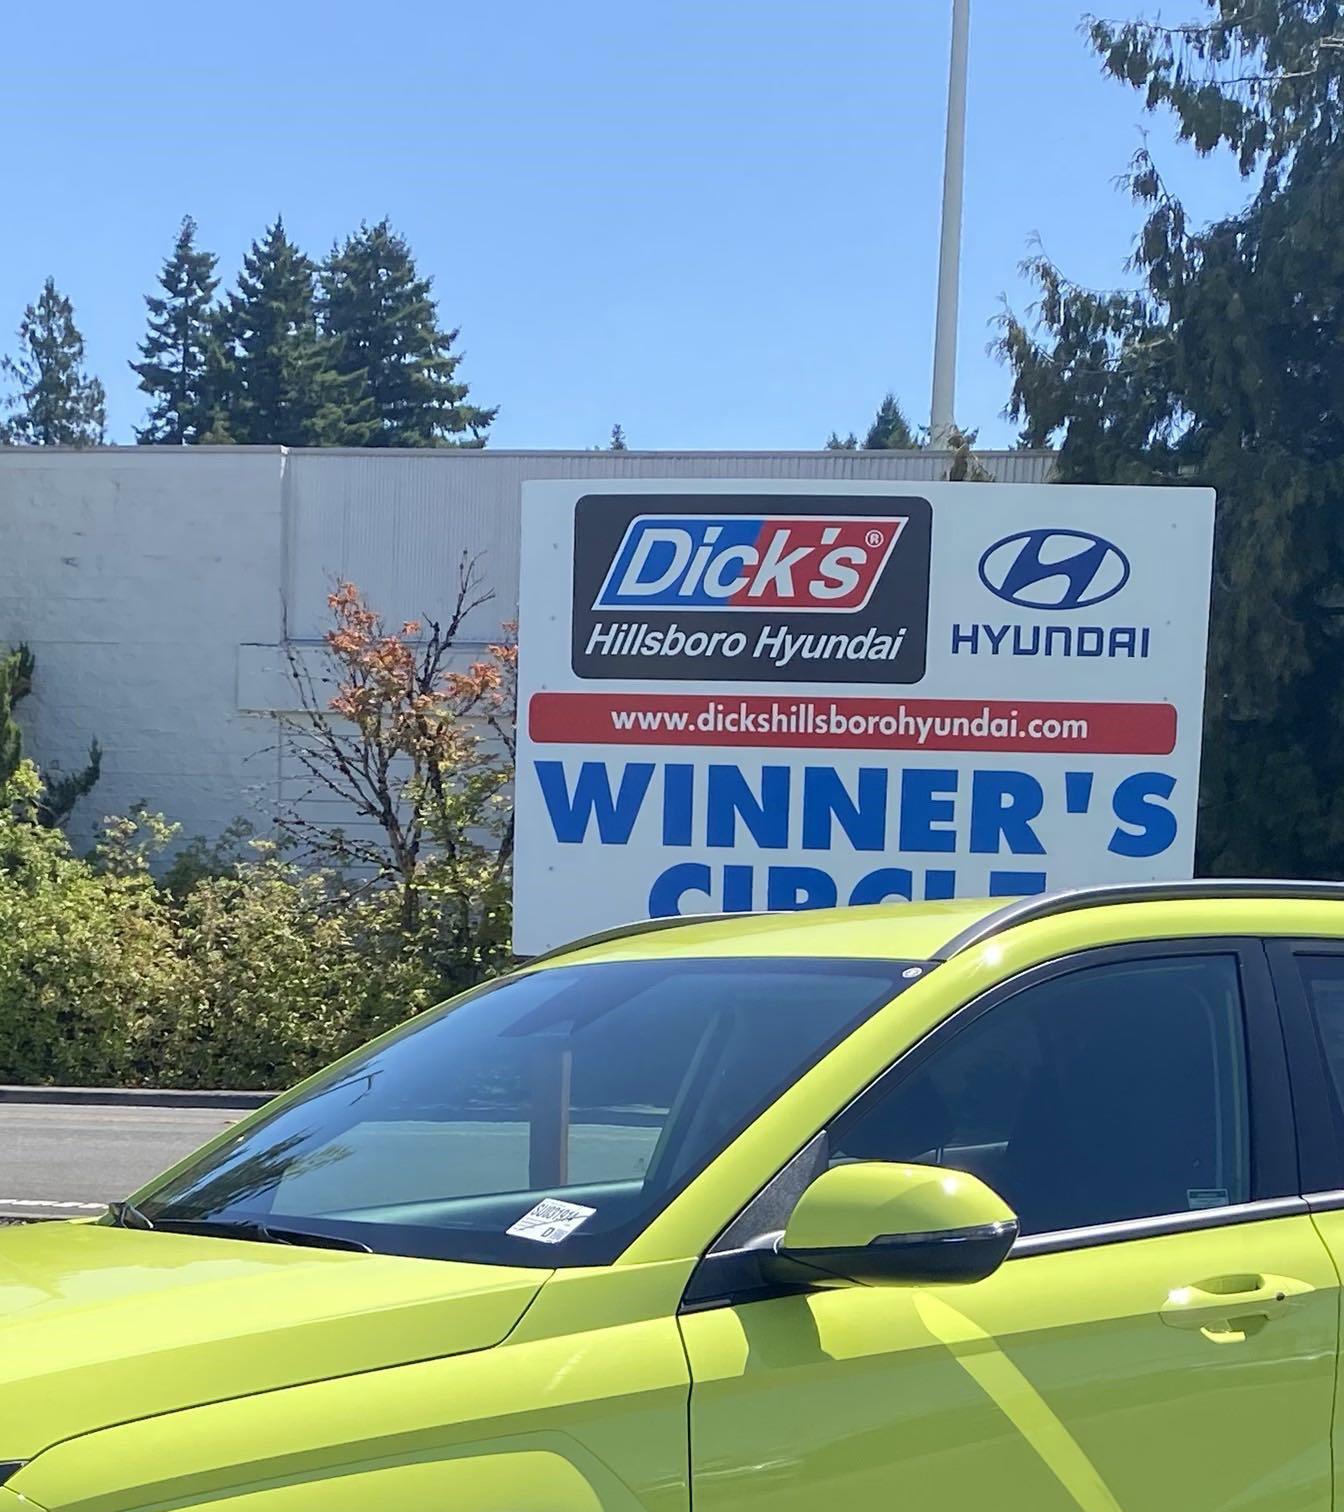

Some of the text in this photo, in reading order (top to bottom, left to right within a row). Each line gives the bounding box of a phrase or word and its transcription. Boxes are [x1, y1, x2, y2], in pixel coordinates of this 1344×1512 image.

[585, 623, 907, 667] Hillsboro Hyundai
[952, 623, 1150, 659] HYUNDAI
[611, 704, 1090, 744] www.dickshillsborohyundai.com
[533, 760, 1178, 858] WINNER'S
